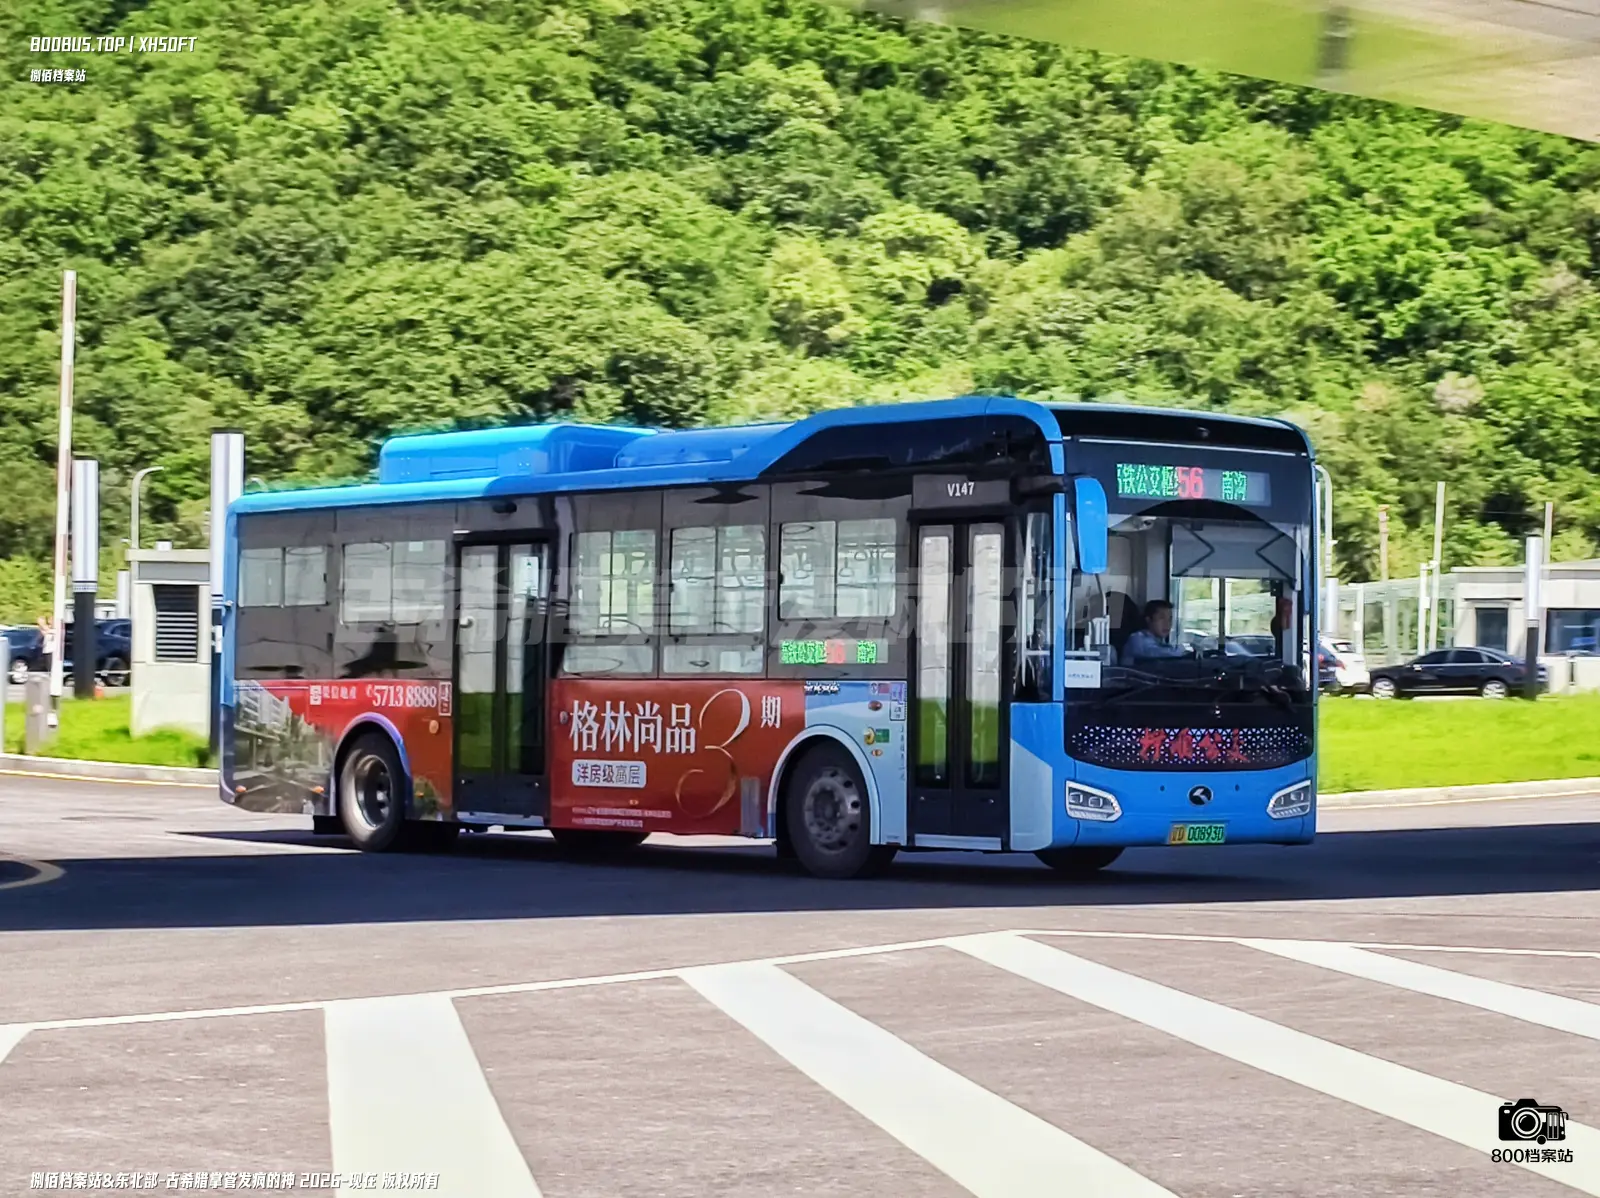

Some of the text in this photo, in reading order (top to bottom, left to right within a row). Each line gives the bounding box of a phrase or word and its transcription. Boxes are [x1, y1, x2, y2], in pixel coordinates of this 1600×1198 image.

[947, 481, 975, 497] V147
[1178, 466, 1204, 498] 56
[576, 762, 641, 785] 洋房级高层
